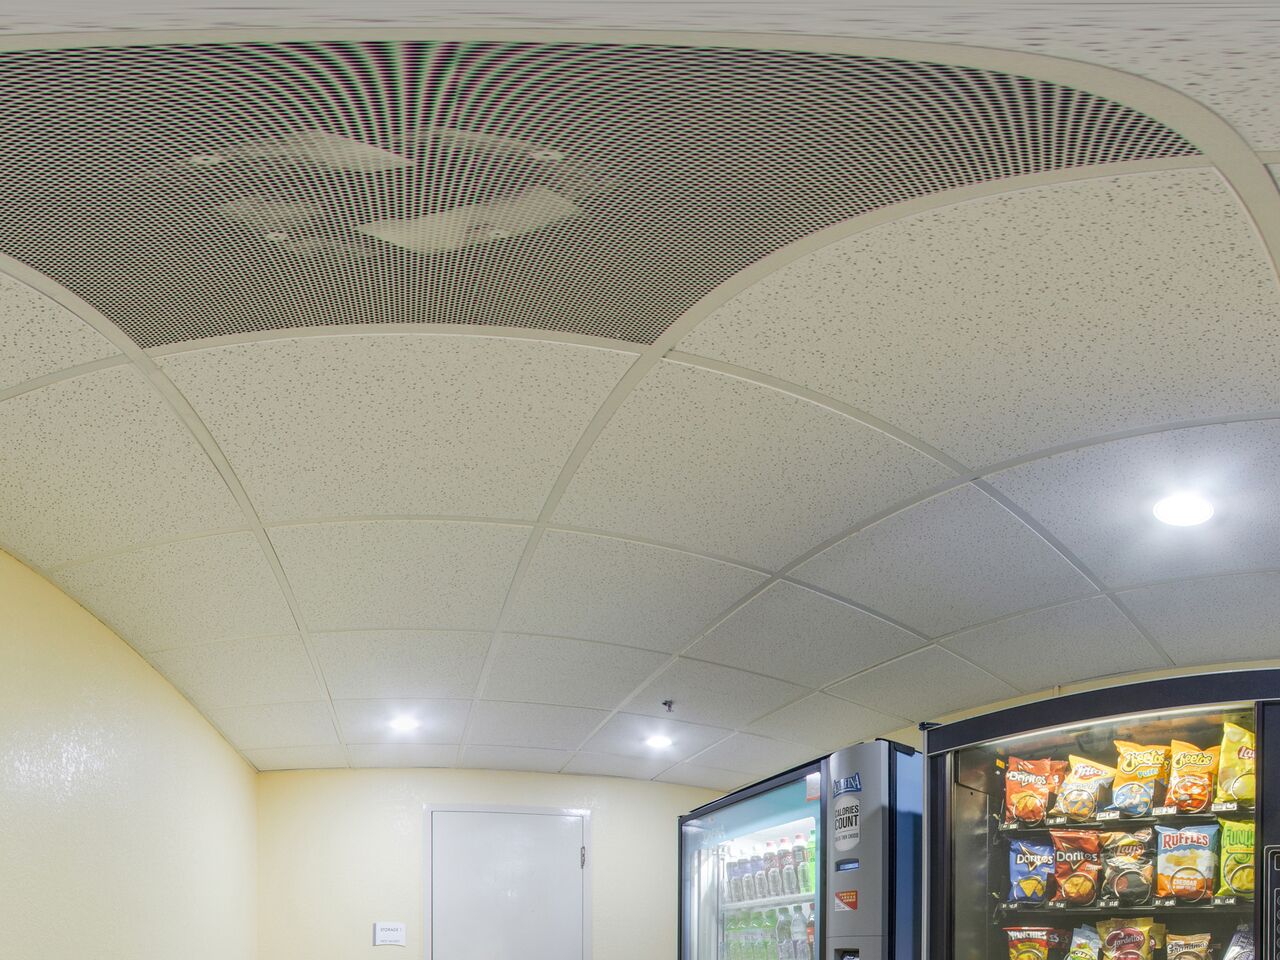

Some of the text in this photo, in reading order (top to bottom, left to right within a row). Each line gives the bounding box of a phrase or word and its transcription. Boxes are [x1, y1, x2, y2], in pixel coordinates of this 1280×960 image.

[1121, 750, 1165, 774] Cheetos
[1173, 751, 1213, 769] Cheetos
[1008, 771, 1047, 784] Doritos
[835, 804, 859, 819] CALORIES
[835, 815, 859, 830] COUNT
[1162, 832, 1209, 849] RUFFLES
[1016, 853, 1054, 865] Doritos
[1056, 851, 1098, 862] Doritos
[1007, 930, 1047, 940] MUNCHIES
